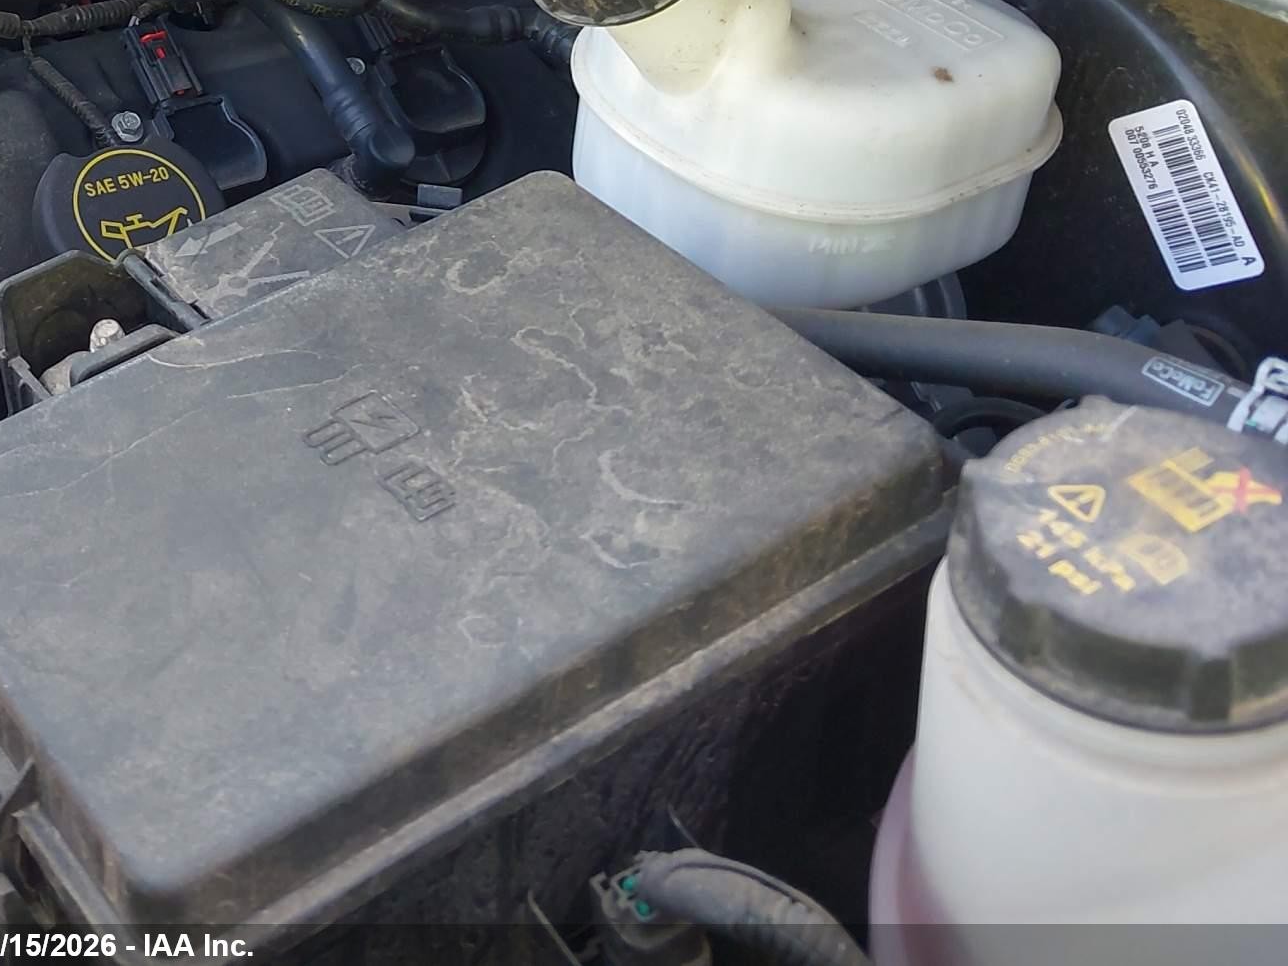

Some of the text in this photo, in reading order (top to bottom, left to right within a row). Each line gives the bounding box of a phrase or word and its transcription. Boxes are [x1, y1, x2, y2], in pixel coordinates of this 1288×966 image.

[1124, 129, 1138, 146] 007
[1134, 125, 1158, 167] 5208 H A
[84, 166, 169, 197] SAE 5W-20
[1175, 108, 1194, 135] 02048
[1186, 134, 1206, 162] 33366
[1242, 254, 1257, 267] A
[1153, 361, 1214, 399] FoMoCo
